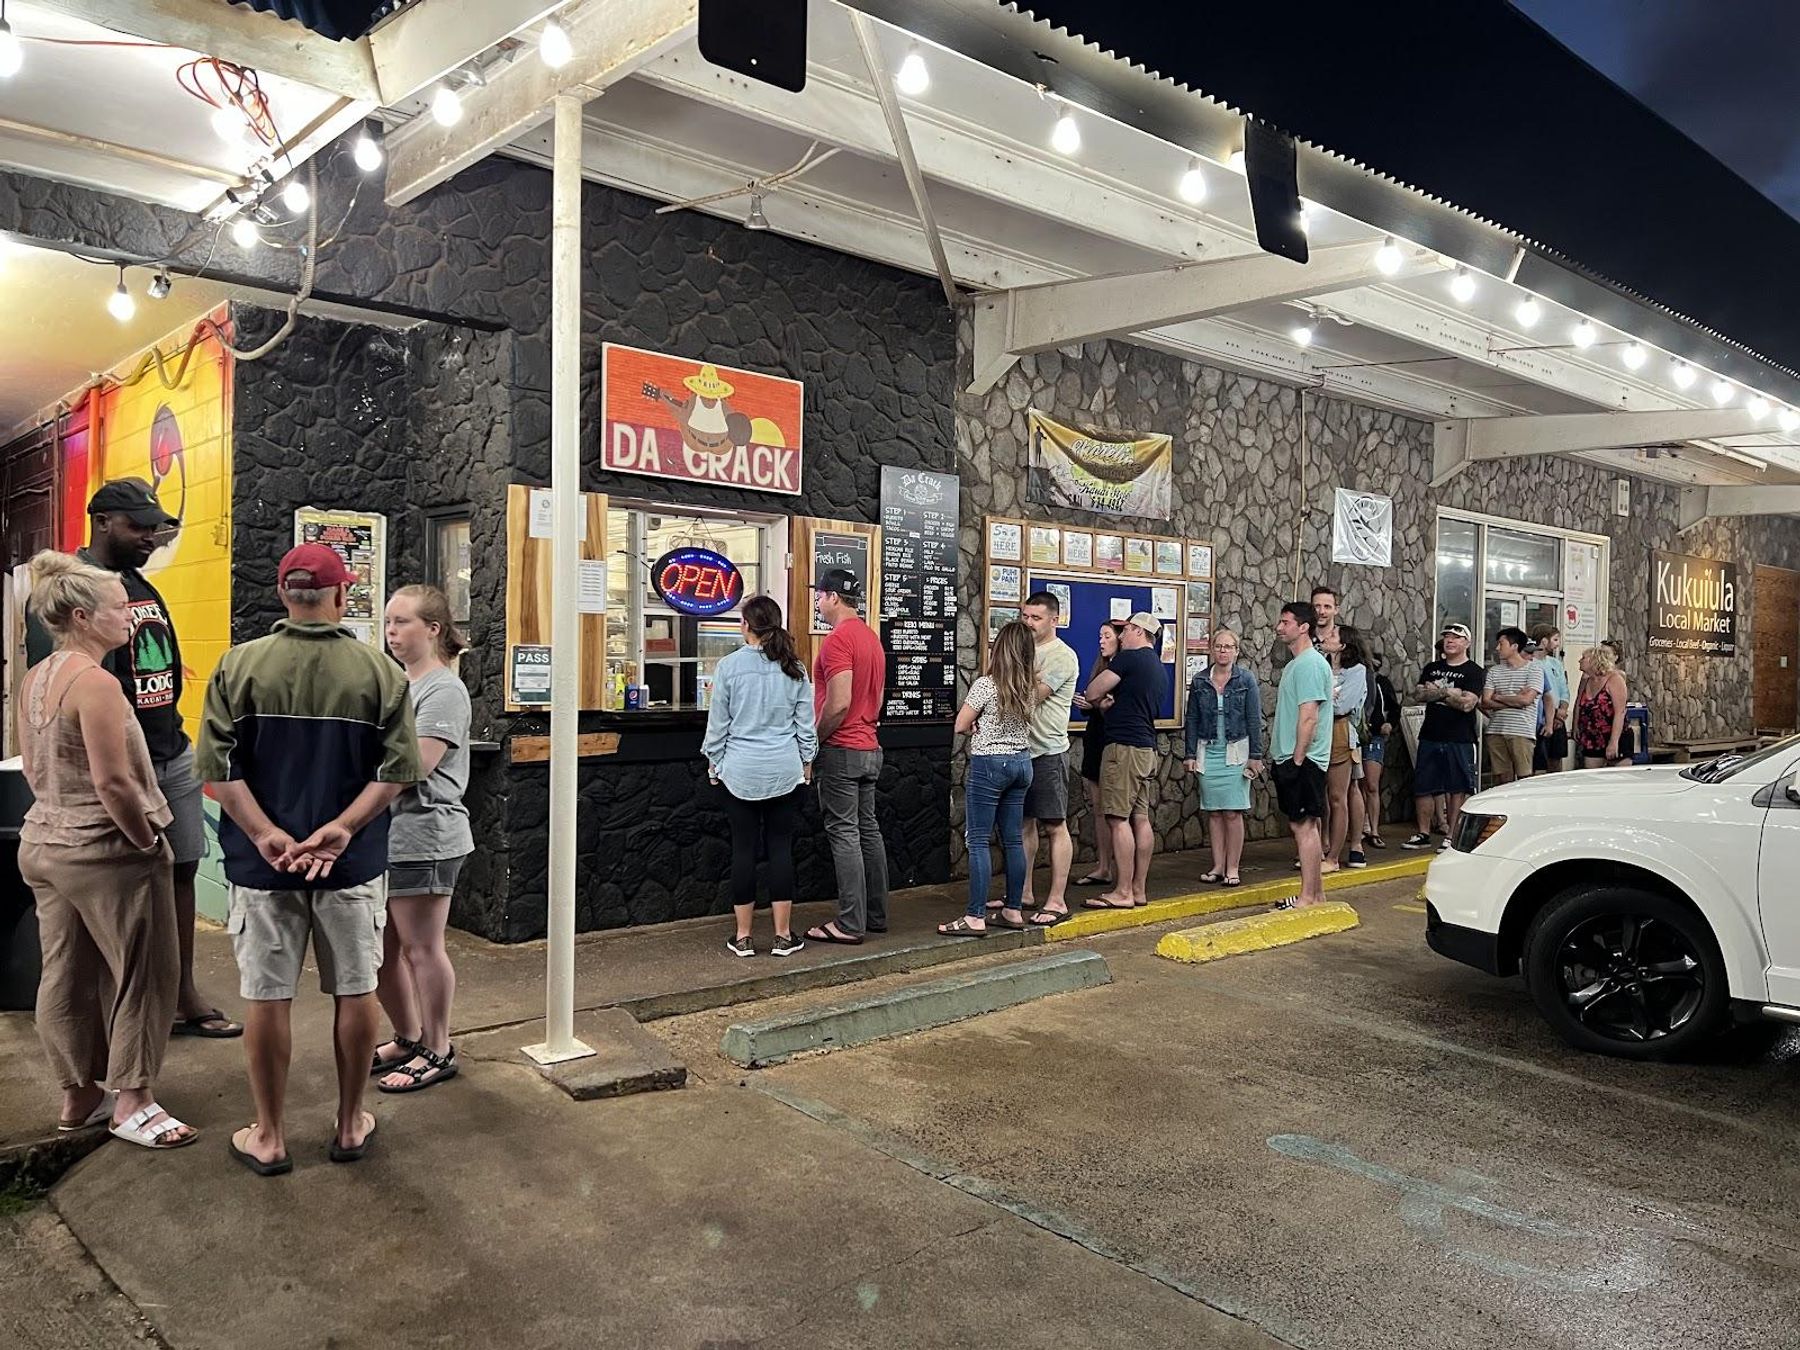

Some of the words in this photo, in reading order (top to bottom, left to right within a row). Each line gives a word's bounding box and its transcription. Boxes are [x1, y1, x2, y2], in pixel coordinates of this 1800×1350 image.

[612, 422, 661, 472] DA
[683, 441, 793, 490] CRACK
[918, 472, 942, 491] Crack
[884, 506, 902, 514] STEP
[885, 537, 902, 545] STEP
[923, 541, 939, 549] STEP
[815, 551, 834, 564] Fresh
[836, 552, 852, 565] Fish
[660, 563, 736, 598] OPEN
[1002, 575, 1018, 584] PAINT
[1660, 607, 1690, 630] Local
[1693, 611, 1731, 633] Market
[1676, 638, 1689, 648] Local
[518, 653, 549, 663] PASS
